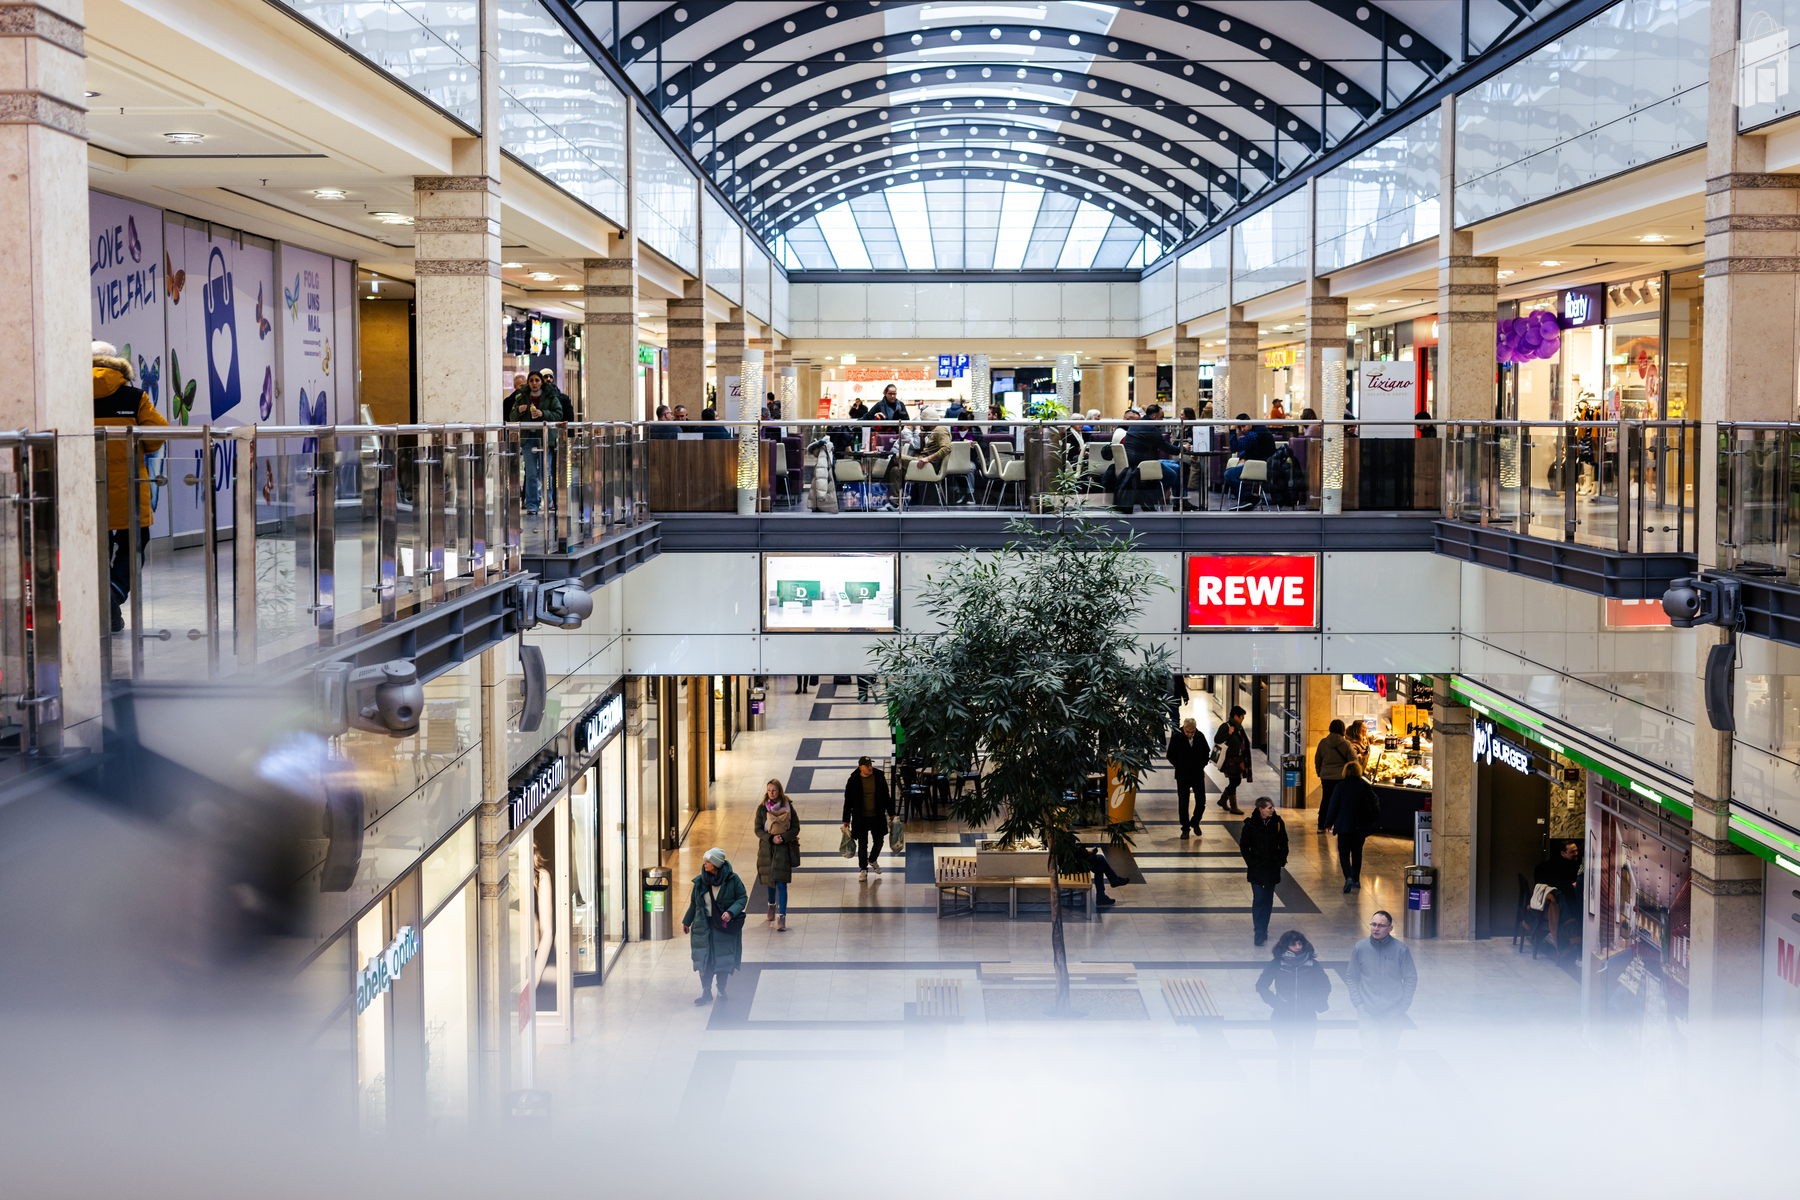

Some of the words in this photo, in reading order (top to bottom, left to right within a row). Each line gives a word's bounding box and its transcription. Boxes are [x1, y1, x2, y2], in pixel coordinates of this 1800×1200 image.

[303, 269, 320, 290] FOLG
[97, 263, 157, 325] VIELFALT
[306, 292, 320, 311] UNS
[307, 314, 321, 333] MAL
[958, 356, 967, 366] P
[845, 369, 931, 382] ROSSMANN
[1366, 373, 1414, 392] Tiziano
[1199, 576, 1304, 606] REWE
[1492, 738, 1529, 775] BURGER
[512, 755, 566, 830] intimissimi
